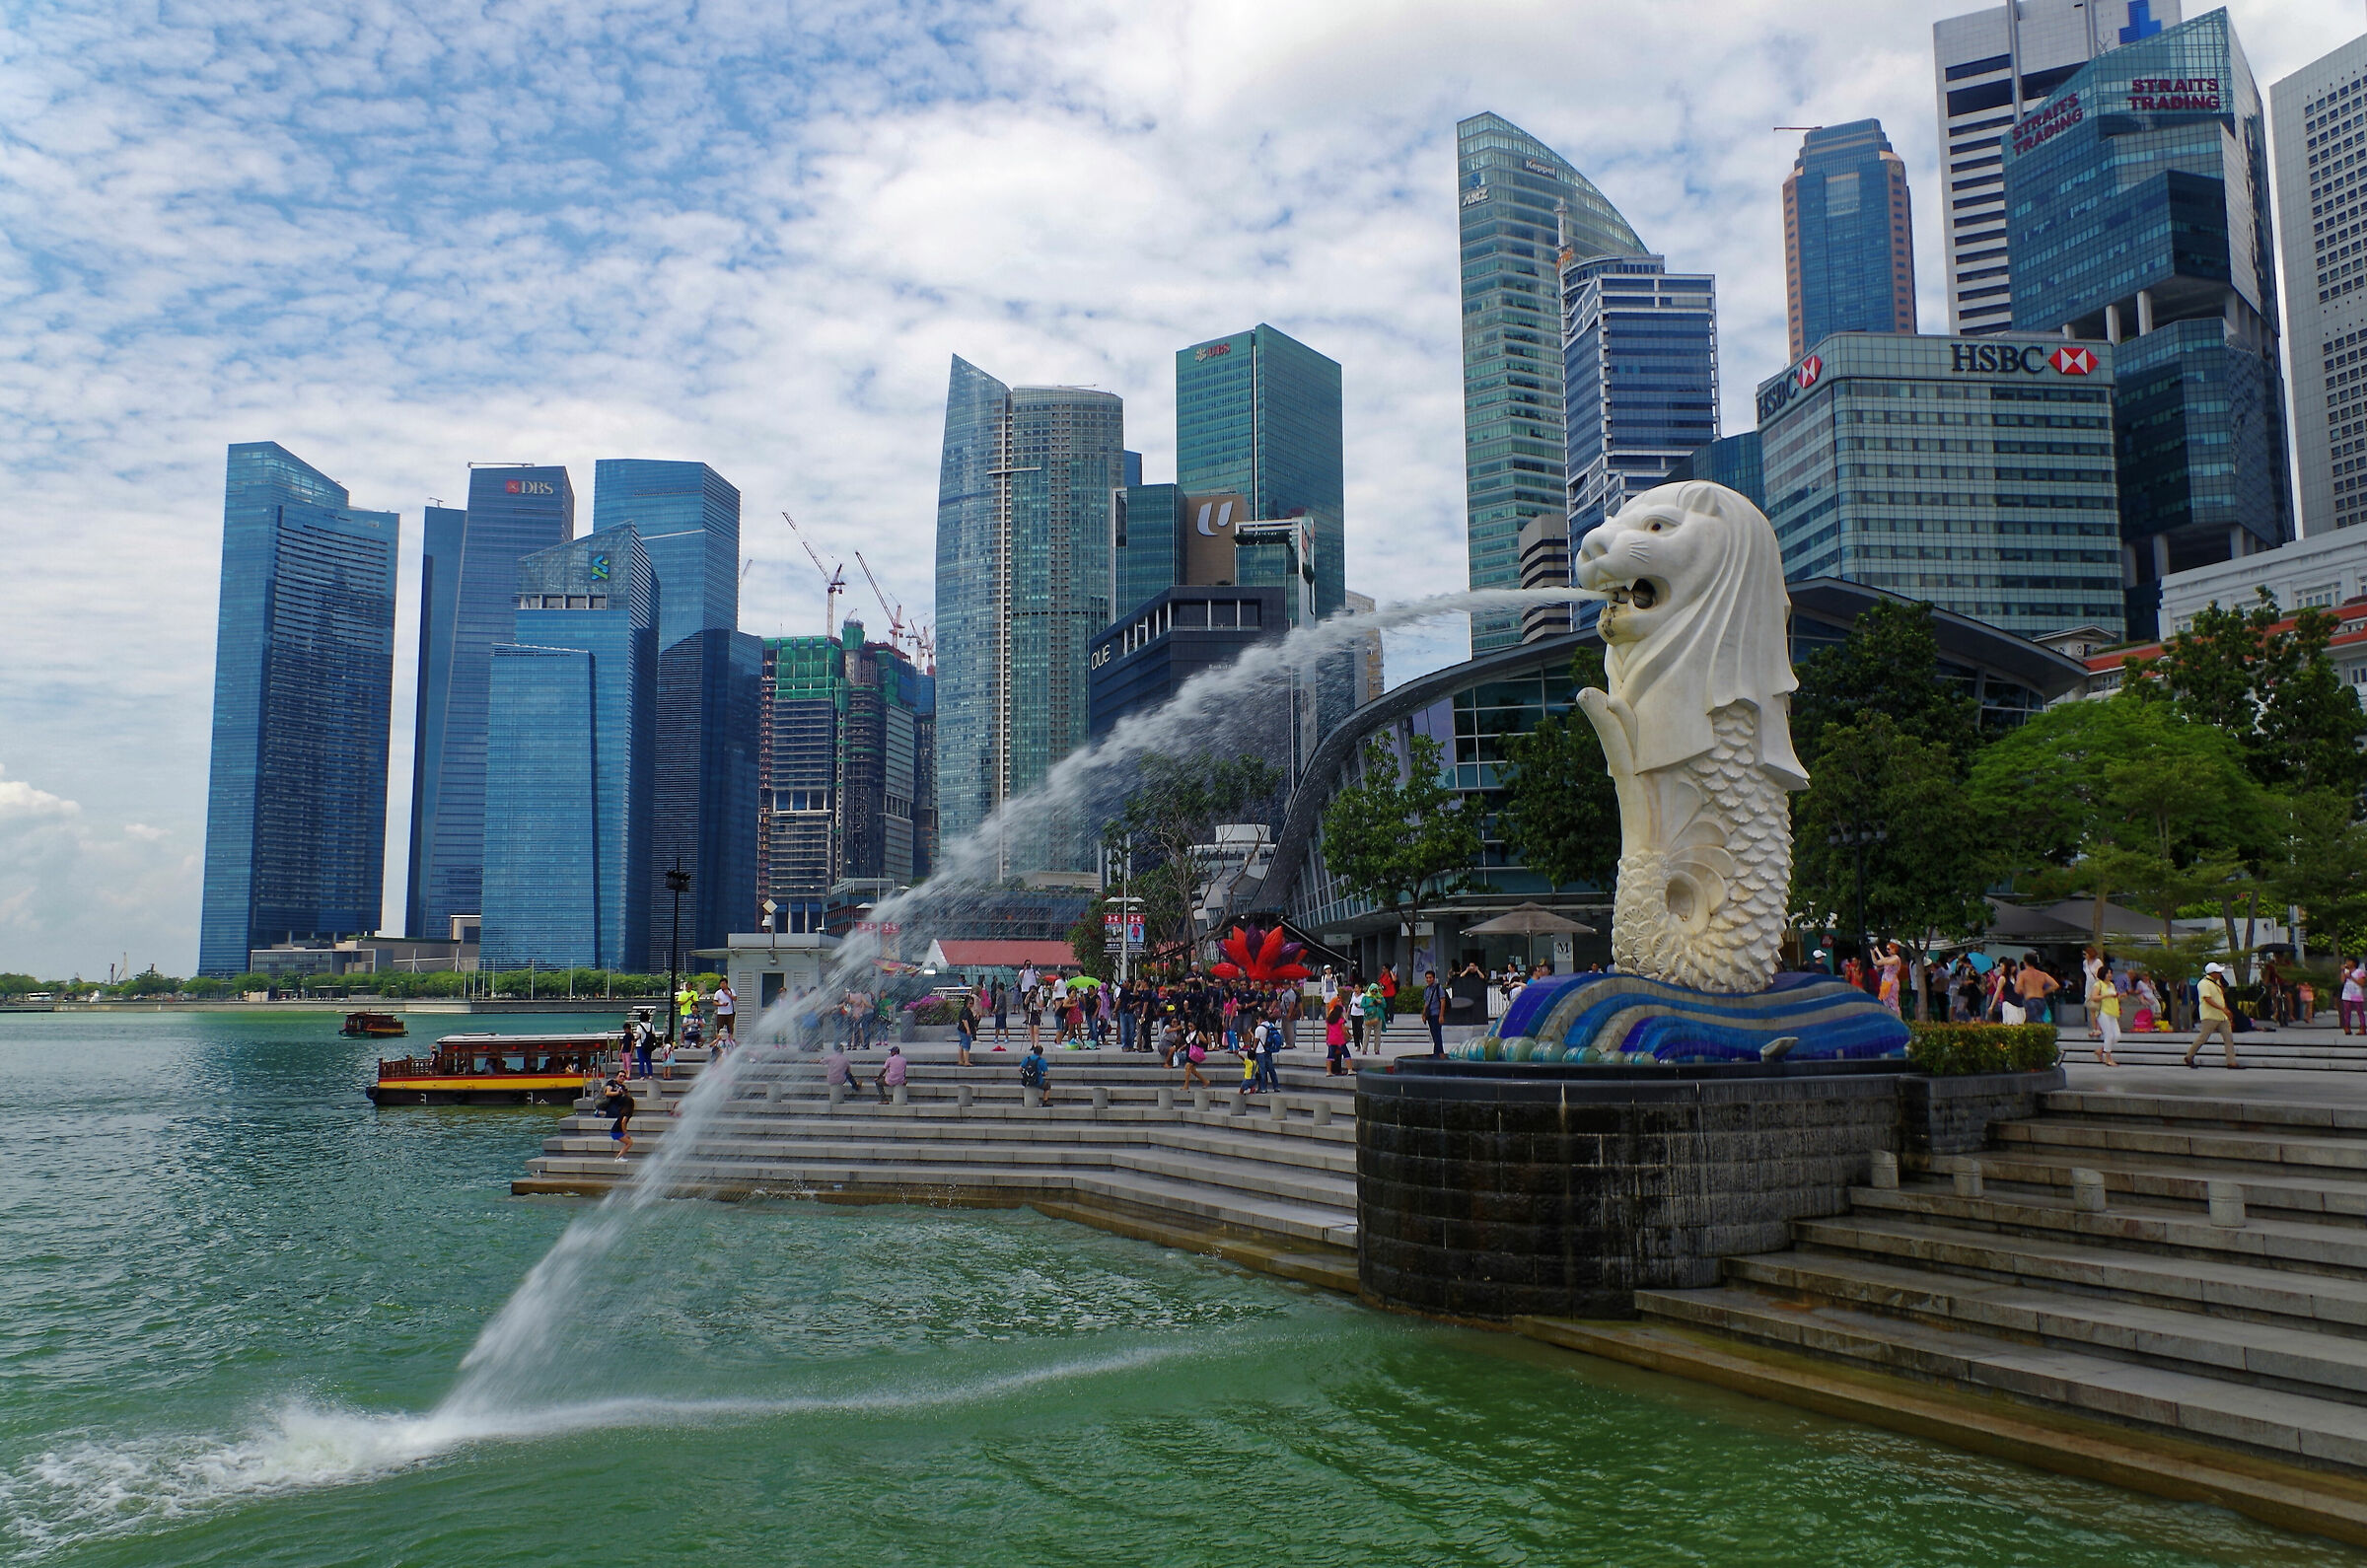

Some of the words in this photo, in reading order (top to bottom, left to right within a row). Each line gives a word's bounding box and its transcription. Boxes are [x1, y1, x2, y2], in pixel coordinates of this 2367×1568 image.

[2131, 78, 2219, 93] STRAITS
[2126, 95, 2220, 110] TRADING
[2013, 92, 2078, 140] STRAITS
[2013, 107, 2083, 156] TRADING
[1526, 159, 1555, 177] Keppel
[1462, 188, 1489, 206] ANZ
[1950, 343, 2044, 374] HSBC
[1757, 370, 1799, 424] HSBC
[521, 480, 554, 495] DBS
[1091, 644, 1111, 671] OUE
[1557, 942, 1569, 954] M
